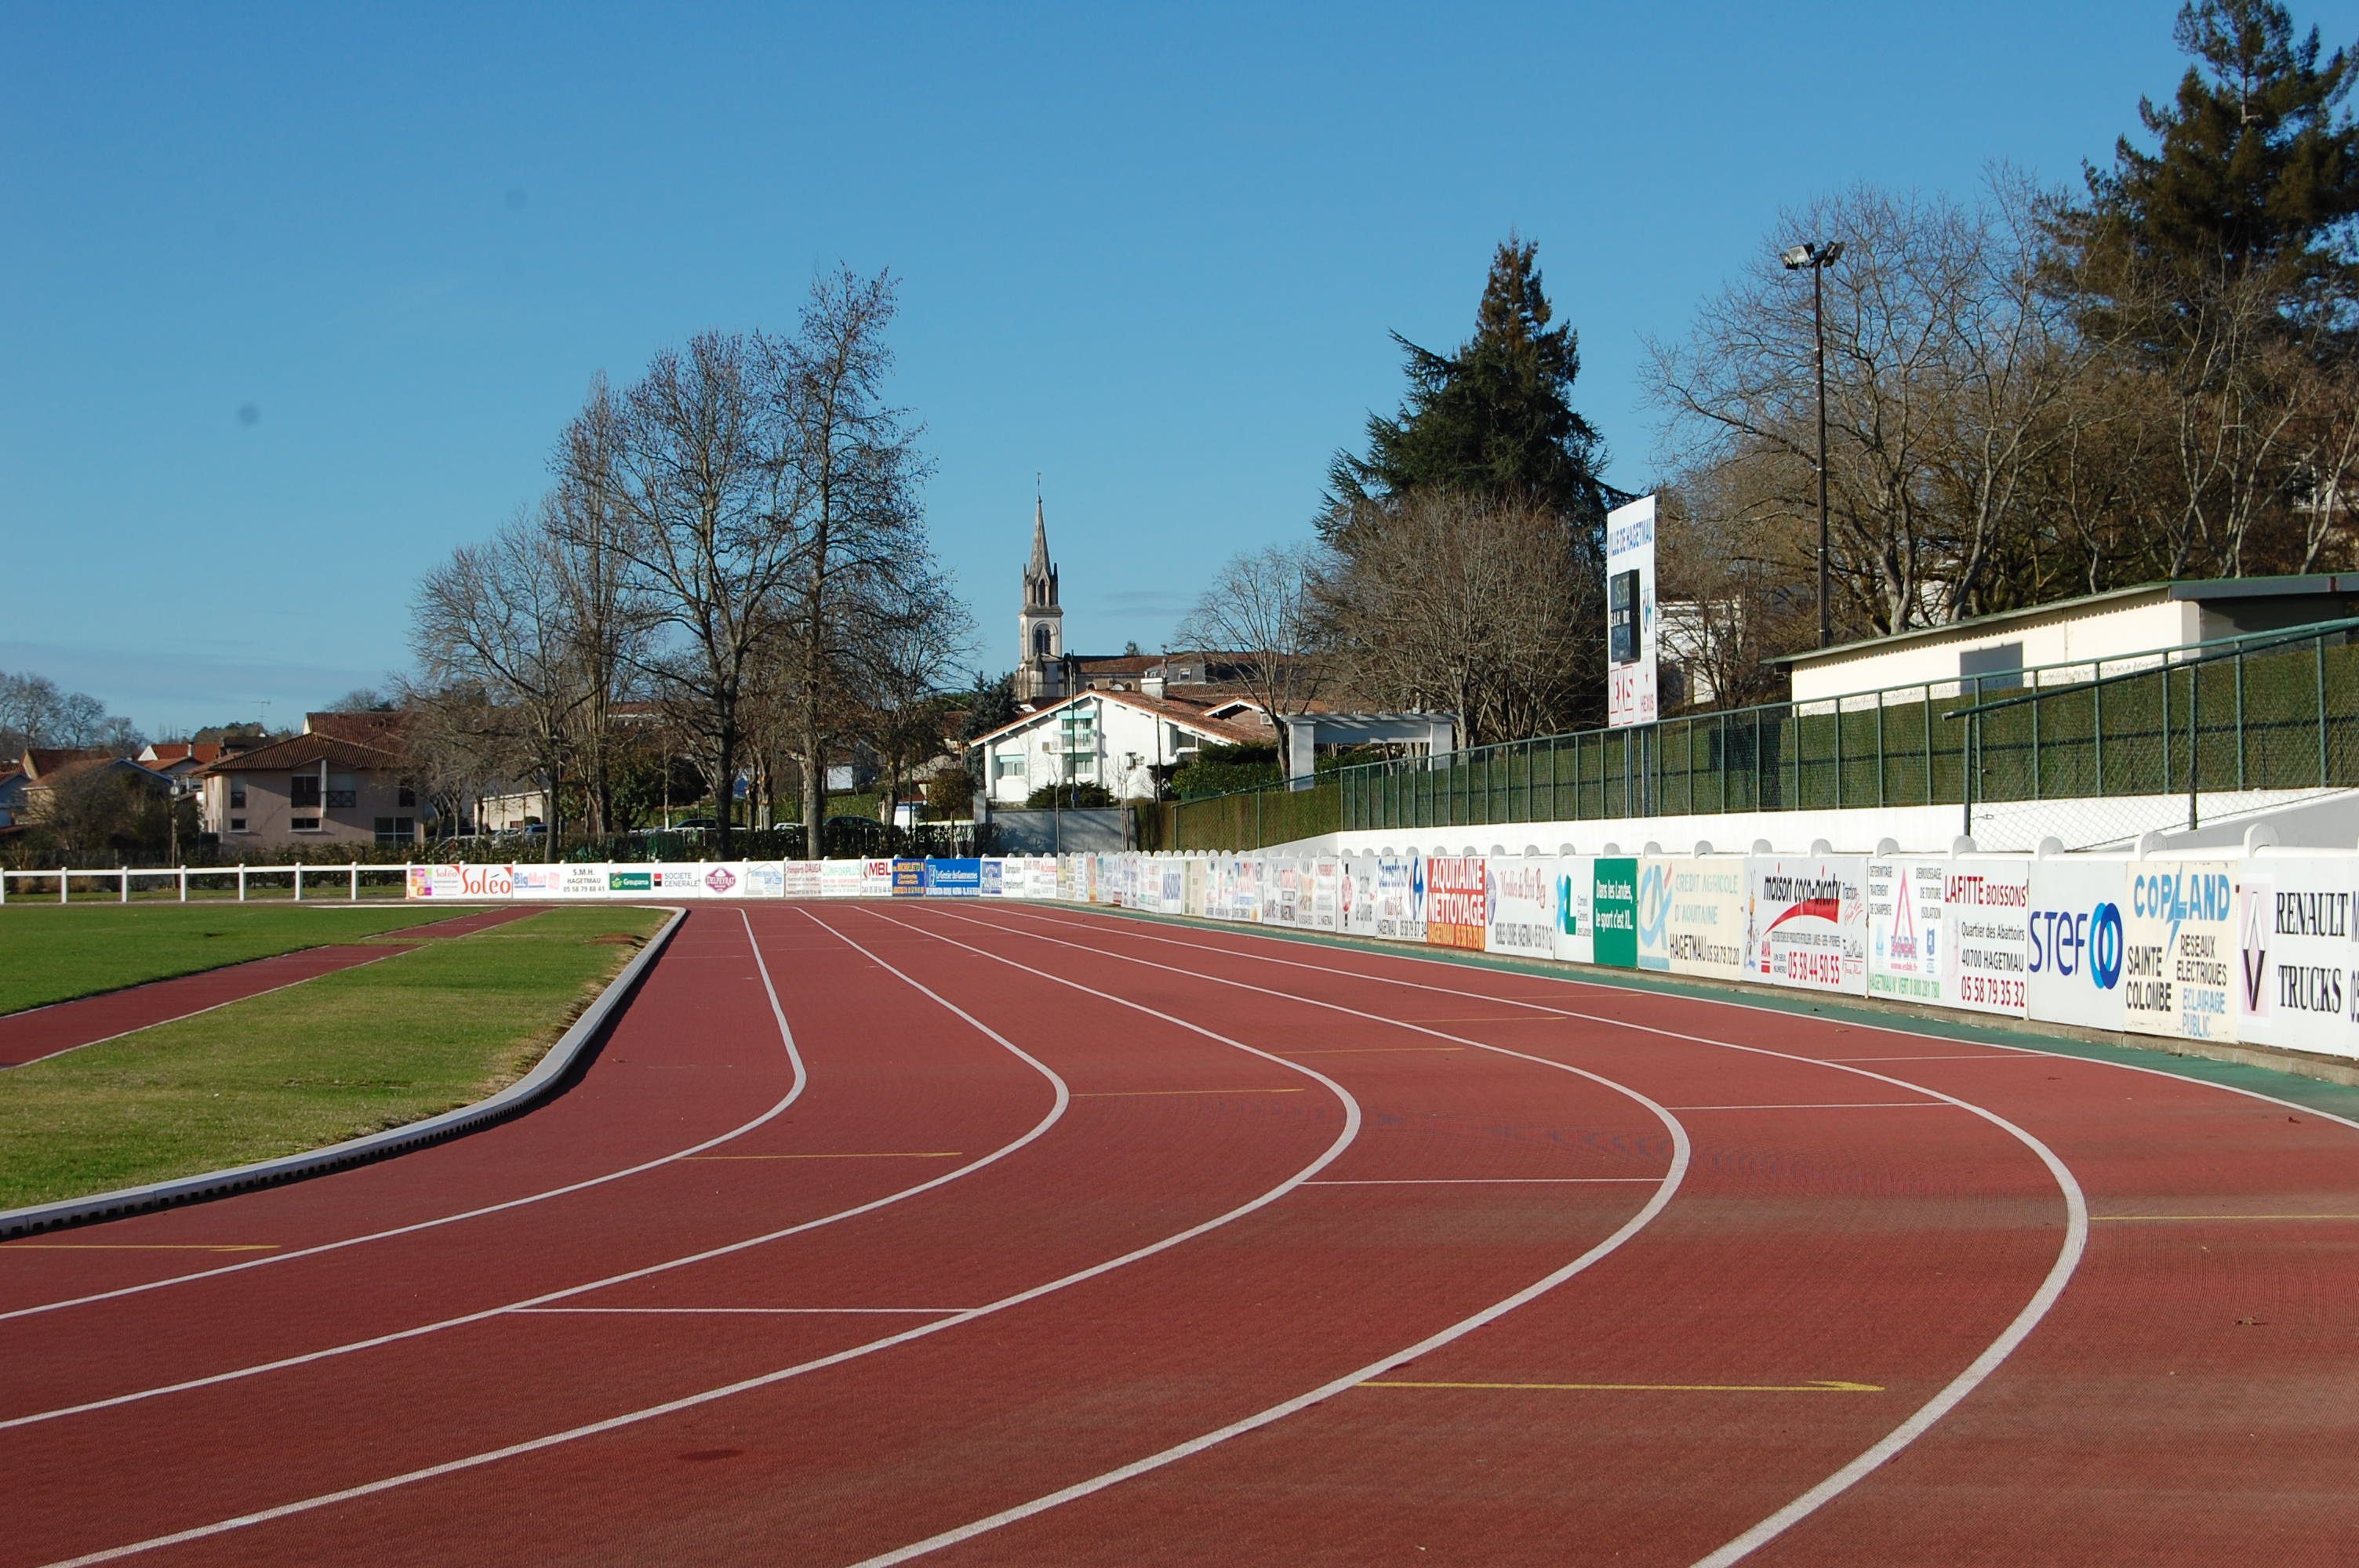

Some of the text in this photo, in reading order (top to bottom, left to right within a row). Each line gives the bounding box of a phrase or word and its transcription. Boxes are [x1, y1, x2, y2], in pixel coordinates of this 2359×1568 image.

[462, 868, 511, 895] Soléo
[869, 862, 891, 876] MBL
[1431, 858, 1483, 892] AQUITAINE
[1675, 873, 1739, 895] CREDIT AGRICOLE
[1763, 862, 1792, 903] maison
[1596, 879, 1607, 898] Dans
[1616, 880, 1633, 903] Landes,
[1944, 875, 2026, 908] LAFITTE BOISSONS
[2133, 872, 2230, 922] COPLAND
[1428, 892, 1484, 927] NETTOYAGE
[1595, 908, 1601, 927] le
[1601, 910, 1613, 932] sport
[2275, 891, 2348, 937] RENAULT
[1961, 922, 2025, 942] Quartier des Abattoirs
[2180, 934, 2215, 958] RESEAUX
[1670, 933, 1707, 961] HAGETMAU
[1707, 945, 1713, 962] 05
[1720, 946, 1726, 964] 79
[1733, 947, 1739, 966] 20
[1961, 949, 2024, 973] 40700 HAGETMAU
[2128, 946, 2162, 977] SAINTE
[1788, 951, 1797, 979] 05
[1799, 953, 1807, 981] 58
[1809, 953, 1818, 982] 44
[1819, 954, 1829, 983] 50
[1830, 955, 1840, 985] 55
[2177, 960, 2226, 986] ELECTRIQUES
[1961, 976, 2025, 1007] 05 58 79 35 32
[2126, 982, 2172, 1012] COLOMBE
[2183, 988, 2226, 1014] ECLAIRAGE
[2277, 965, 2342, 1014] TRUCKS
